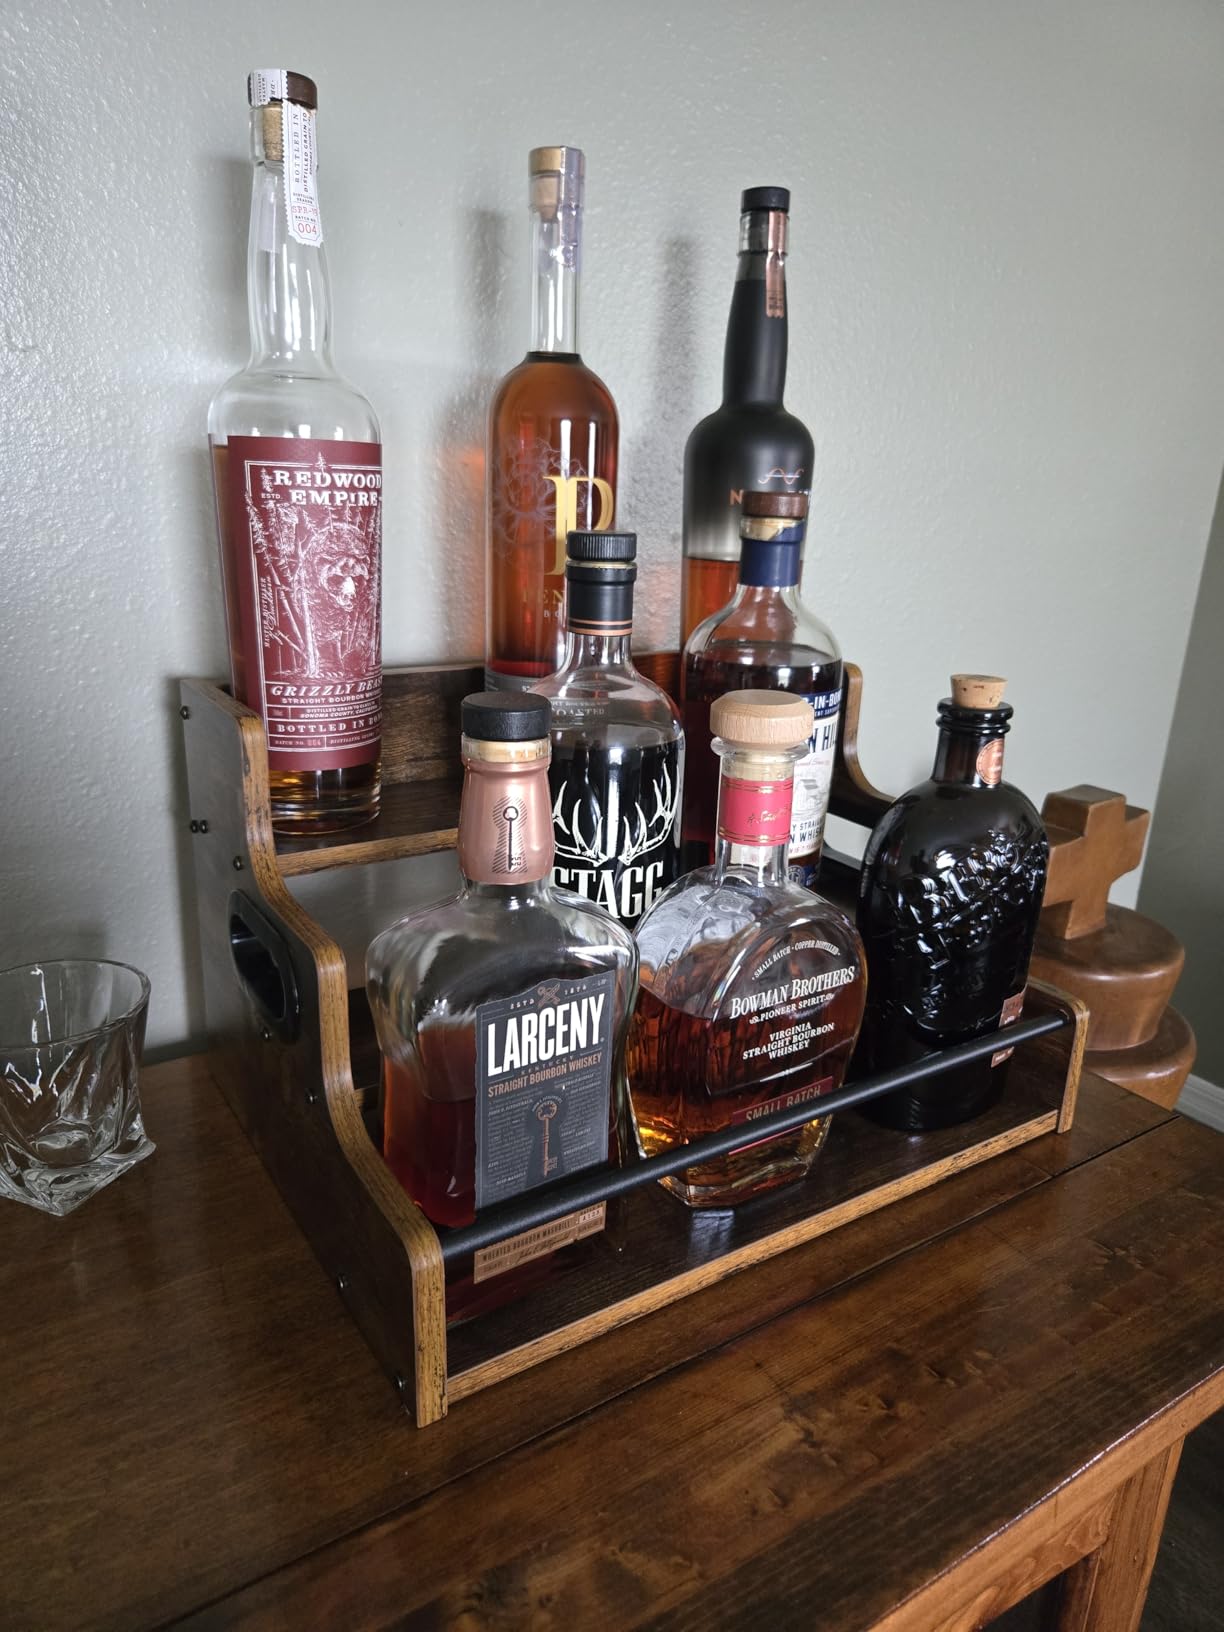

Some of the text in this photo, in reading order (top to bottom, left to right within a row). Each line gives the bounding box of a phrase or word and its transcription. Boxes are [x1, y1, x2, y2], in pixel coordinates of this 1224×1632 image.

[292, 113, 301, 184] BOTTLED IN
[298, 222, 317, 235] 004
[273, 469, 382, 488] REDWOOD
[289, 489, 378, 507] EMPIRE
[271, 684, 356, 697] GRIZZLY
[328, 694, 365, 704] BOURBON
[277, 722, 347, 733] BOTTLED
[353, 719, 365, 729] IN
[551, 861, 664, 919] STAGG
[754, 940, 840, 978] SMALL BATCH COPPER DISTILLED
[729, 965, 856, 1020] BOWMAN BROTHERS
[510, 998, 535, 1010] ESTD
[760, 995, 825, 1021] PIONEER SPIRIT
[487, 993, 606, 1077] LARCENY
[742, 1022, 836, 1060] STRAIGHT BOURBON
[769, 1022, 812, 1042] VIRGINIA
[768, 1039, 811, 1060] WHISKEY
[487, 1052, 602, 1098] STRAIGHT BOURBON WHISKEY
[786, 1085, 821, 1107] BATCH
